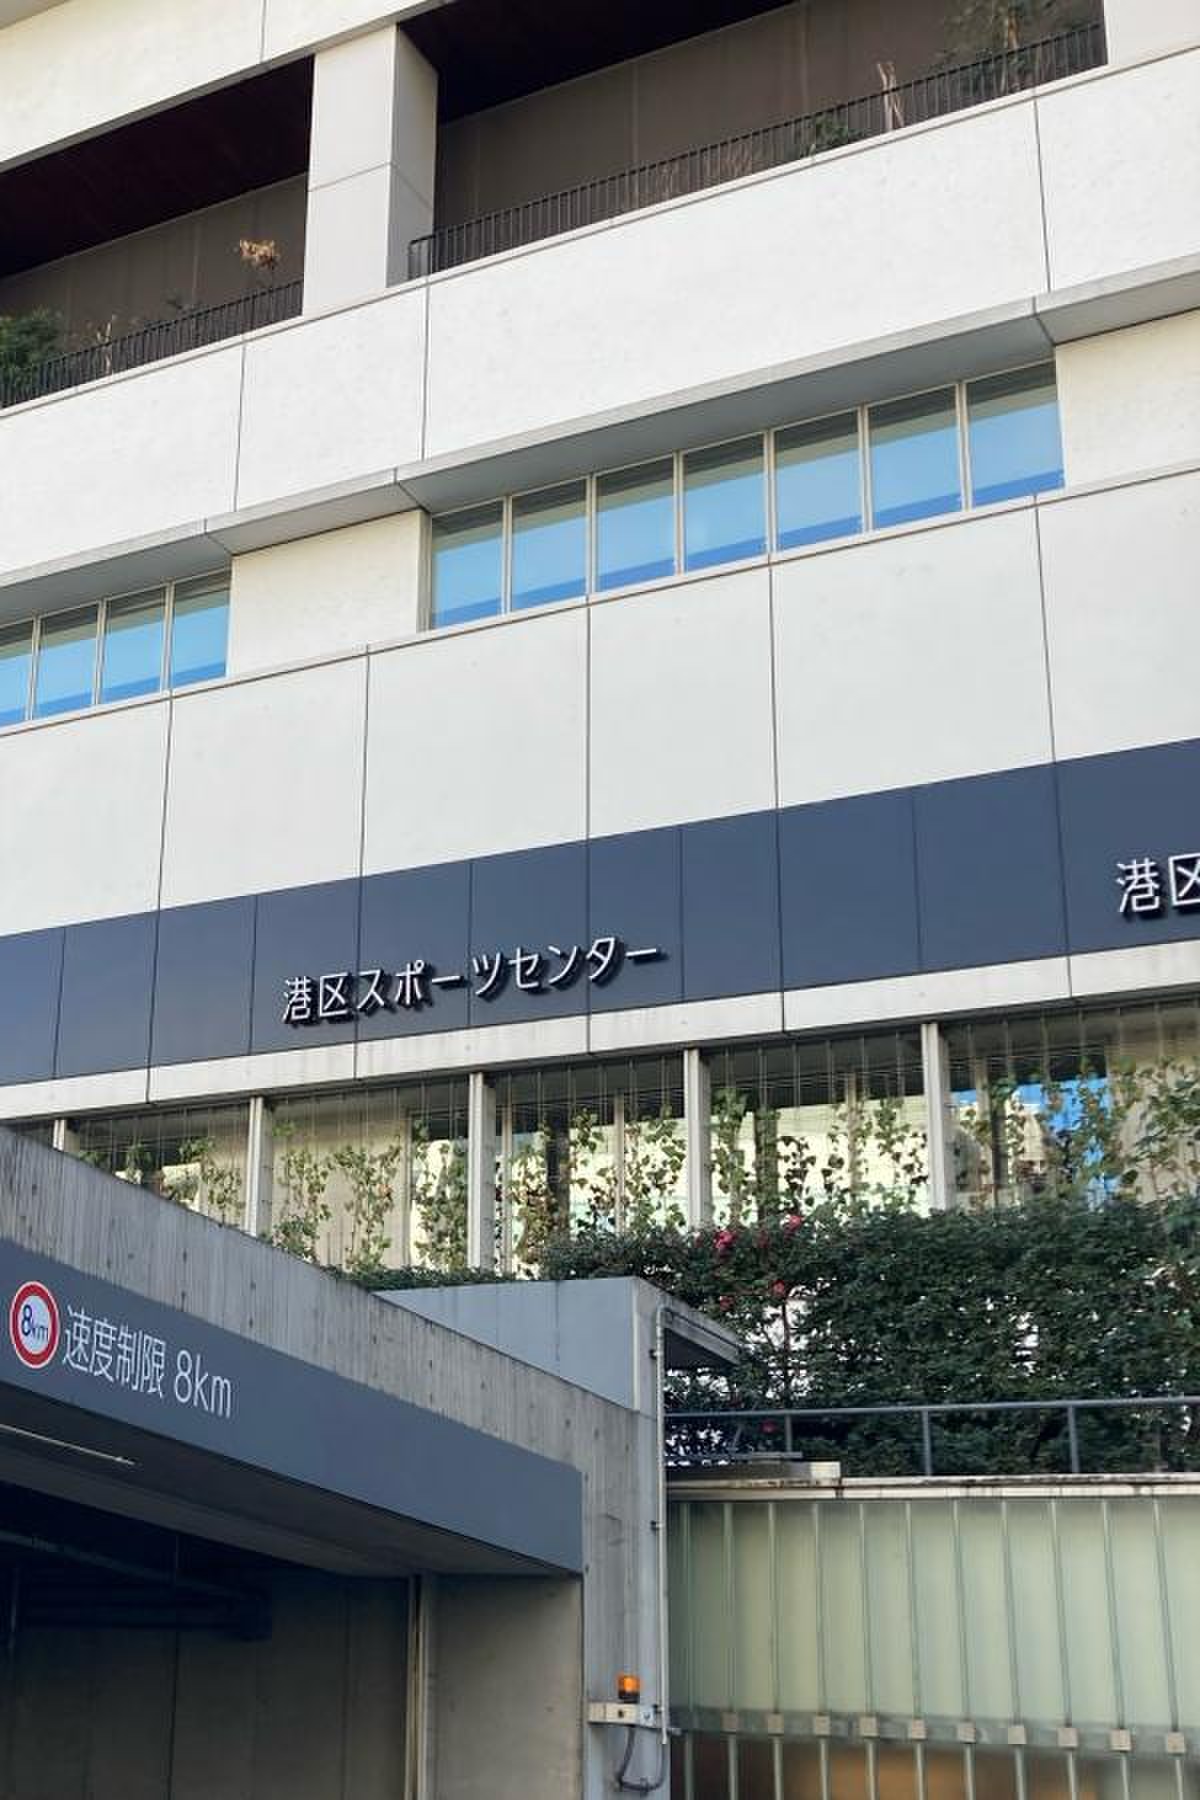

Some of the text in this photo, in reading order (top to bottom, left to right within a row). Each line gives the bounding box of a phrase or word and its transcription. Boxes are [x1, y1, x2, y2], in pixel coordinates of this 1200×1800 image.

[282, 936, 657, 1022] 港区スポーツセンター
[61, 1304, 232, 1419] 速度制限 8km
